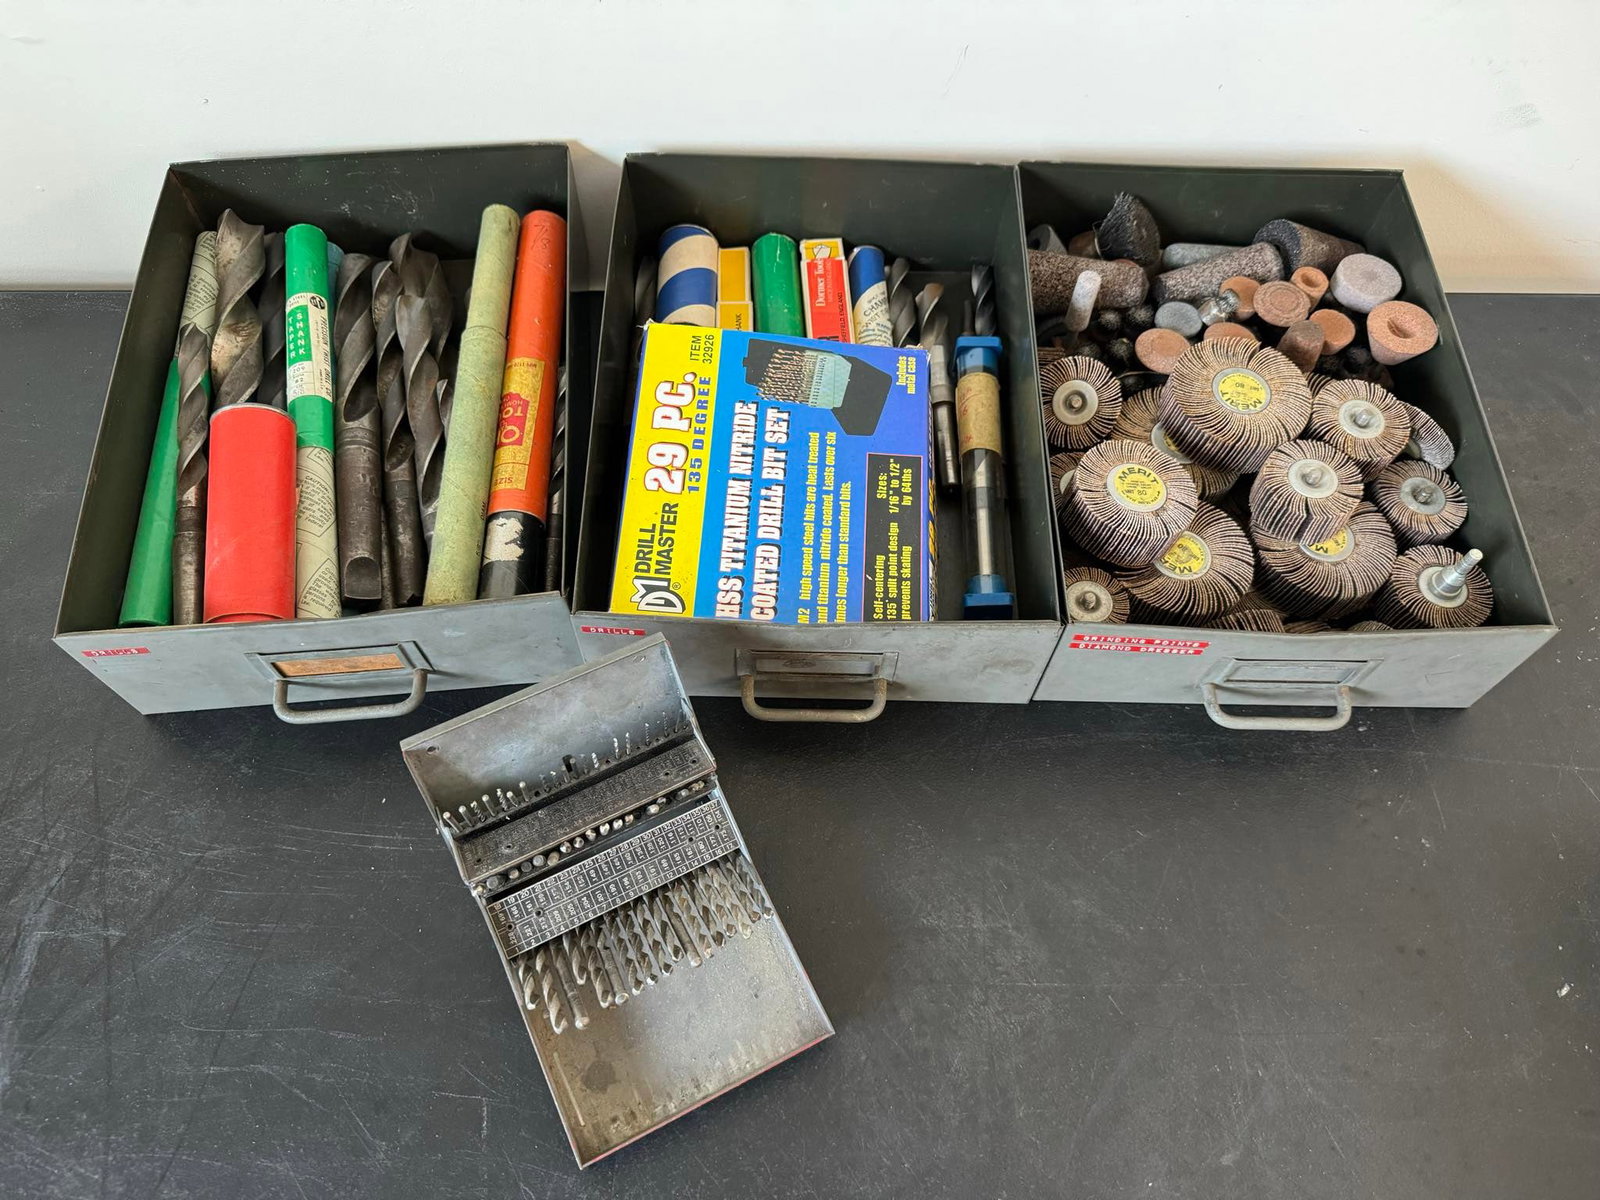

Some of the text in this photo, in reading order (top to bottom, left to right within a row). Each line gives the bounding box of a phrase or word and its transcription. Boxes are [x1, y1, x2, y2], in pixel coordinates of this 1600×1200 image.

[815, 277, 826, 307] Dormer
[296, 312, 305, 355] SHANK
[690, 335, 702, 361] ITEM
[702, 334, 715, 364] 32926
[896, 356, 907, 386] Includes
[907, 356, 916, 394] metal case
[1220, 390, 1263, 410] MERIT
[644, 371, 698, 495] 29 PC.
[688, 376, 711, 494] 135 DEGREE
[876, 472, 888, 499] Sizes:
[890, 478, 900, 488] to
[901, 468, 912, 505] by 64ths
[1118, 467, 1159, 485] MERIT
[715, 400, 759, 619] HSS TITANIUM NITRIDE
[750, 406, 791, 621] COATED DRILL BIT SET
[888, 489, 899, 513] 1/16"
[654, 502, 679, 575] MASTER
[797, 432, 820, 624] M2 high speed steel bits are heat treated
[817, 431, 836, 624] and titanium nitride coated. Lasts over six
[887, 522, 899, 552] design
[634, 523, 657, 573] DRILL
[834, 481, 852, 624] imes longer than standard bits.
[887, 553, 899, 577] point
[1160, 557, 1193, 574] MER
[873, 554, 886, 620] Self-centering
[887, 576, 898, 599] split
[900, 545, 912, 620] prevents skating
[590, 627, 635, 635] DRILLS
[1083, 636, 1146, 644] GRINDING
[1079, 643, 1132, 651] DIAMOND
